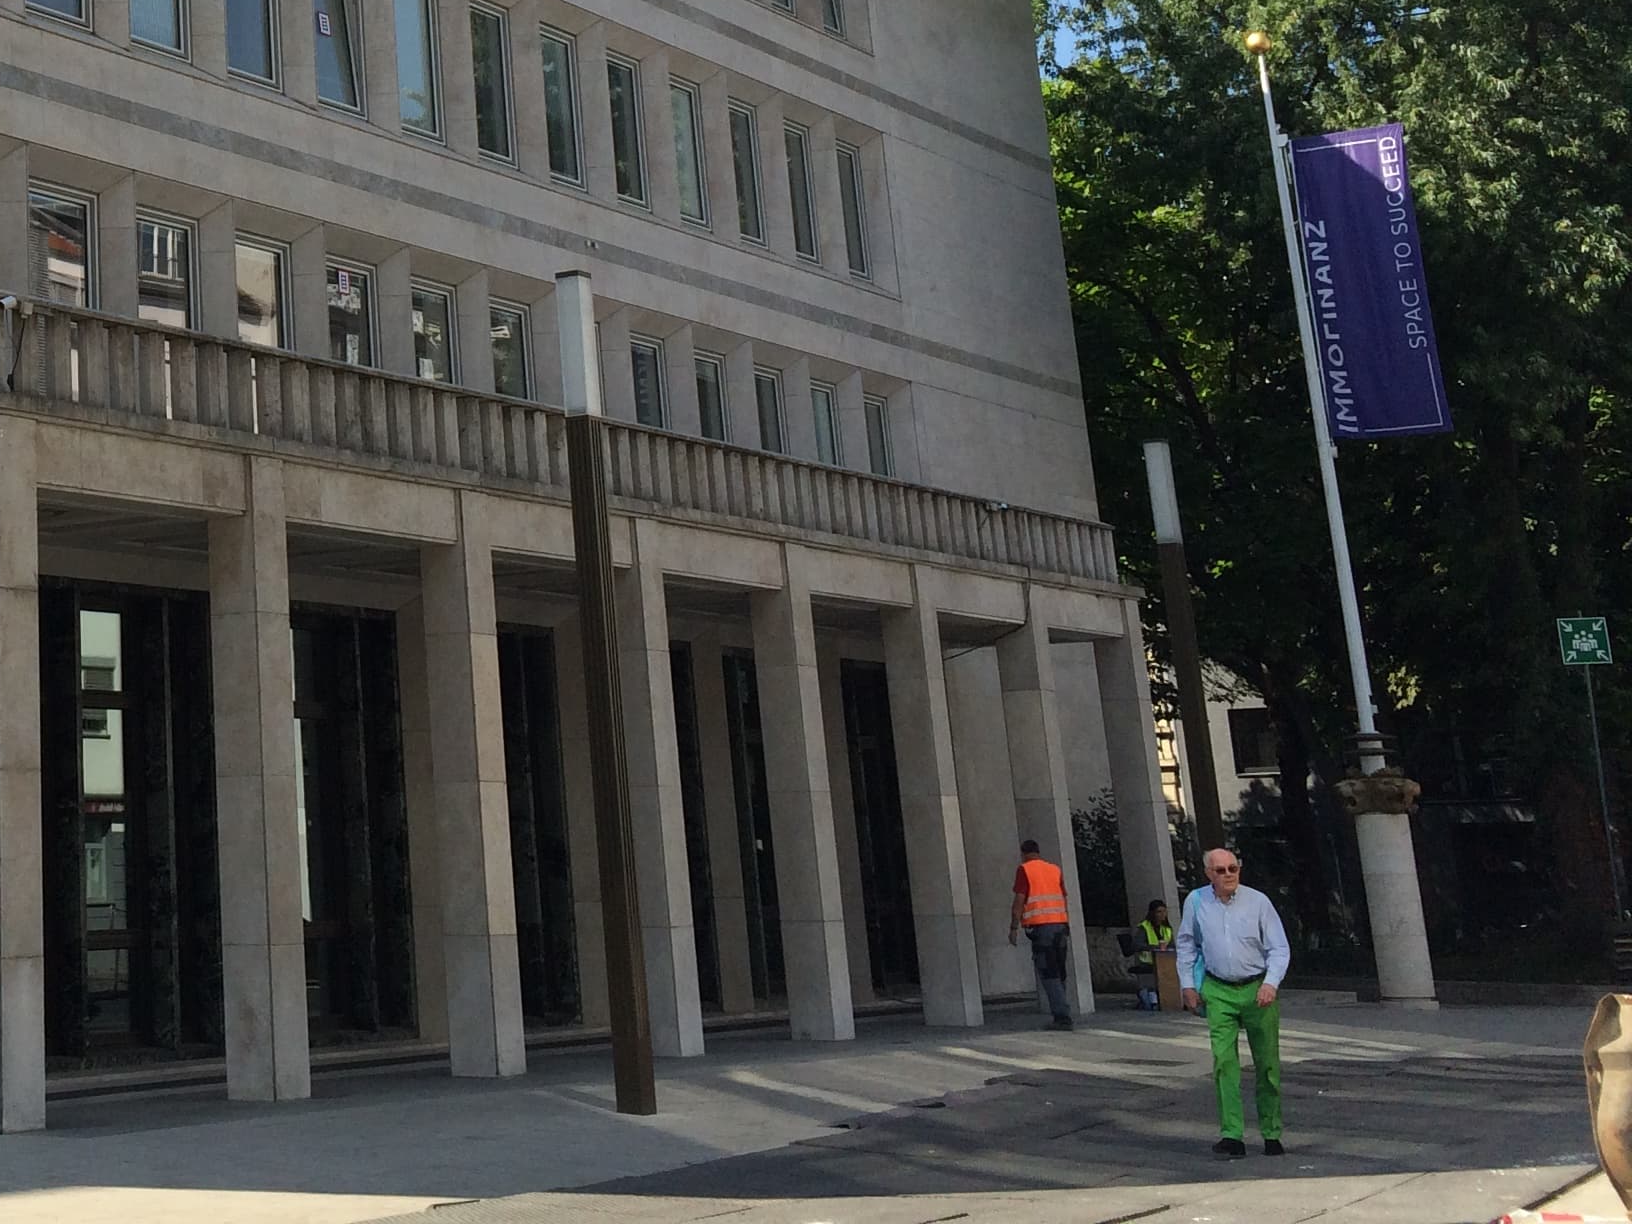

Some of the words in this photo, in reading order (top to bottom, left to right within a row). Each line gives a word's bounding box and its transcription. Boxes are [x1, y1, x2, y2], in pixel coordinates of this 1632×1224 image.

[1379, 136, 1409, 235] SUCCEED
[1394, 242, 1413, 273] TO
[1399, 279, 1427, 349] SPACE
